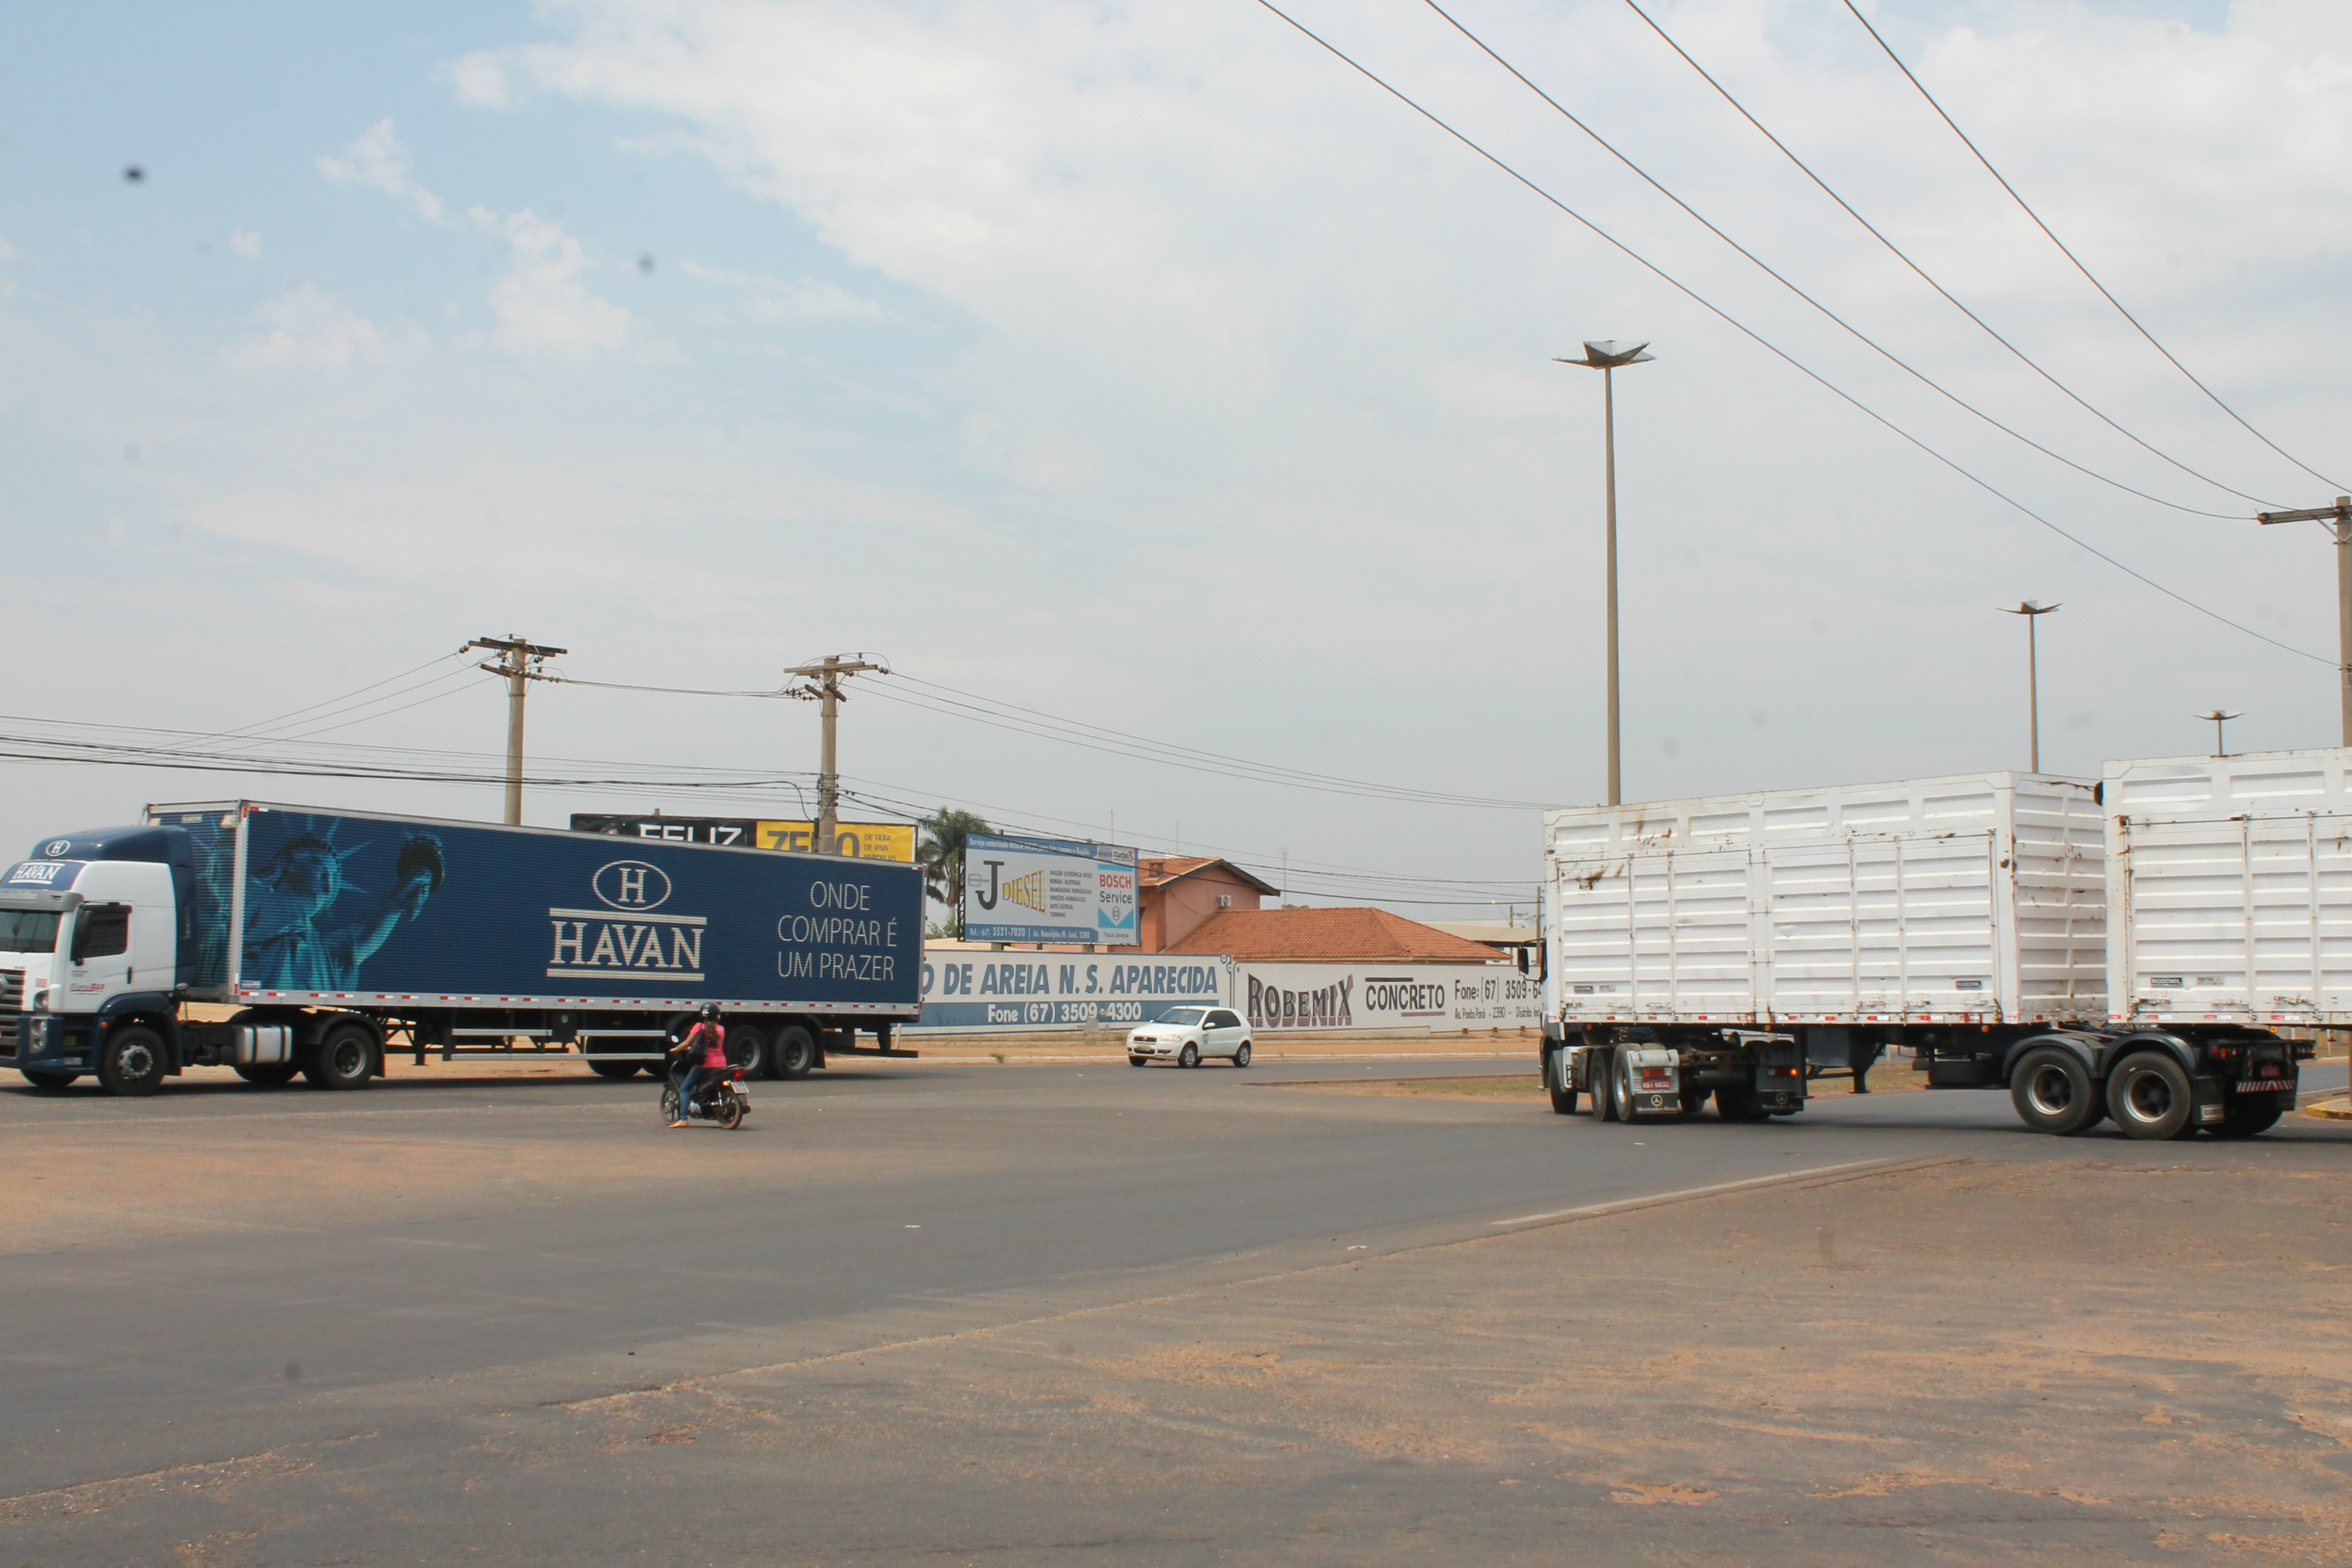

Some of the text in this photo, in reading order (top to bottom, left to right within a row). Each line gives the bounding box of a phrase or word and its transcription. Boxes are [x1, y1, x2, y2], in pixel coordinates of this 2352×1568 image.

[50, 842, 65, 854] H
[767, 830, 860, 857] ZEO
[11, 865, 63, 880] HAVAN
[618, 868, 648, 903] H
[1099, 874, 1132, 888] BOSCH
[810, 881, 871, 911] ONDE
[1002, 870, 1045, 912] DIESEL
[1100, 891, 1132, 904] Service
[550, 920, 705, 969] HAVAN
[777, 915, 898, 947] COMPRAR É
[992, 926, 1026, 937] 3521-7020
[778, 951, 895, 981] UM PRAZER
[943, 963, 973, 995] DE
[979, 963, 1050, 995] AREIA
[1058, 965, 1080, 994] N.
[1085, 964, 1103, 994] S.
[1109, 965, 1218, 994] APARECIDA
[1247, 973, 1353, 1028] ROBEMIX
[1365, 984, 1445, 1011] CONCRETO
[1481, 976, 1499, 1004] (67)
[987, 1004, 1019, 1023] Fone
[1024, 1002, 1055, 1024] (67)
